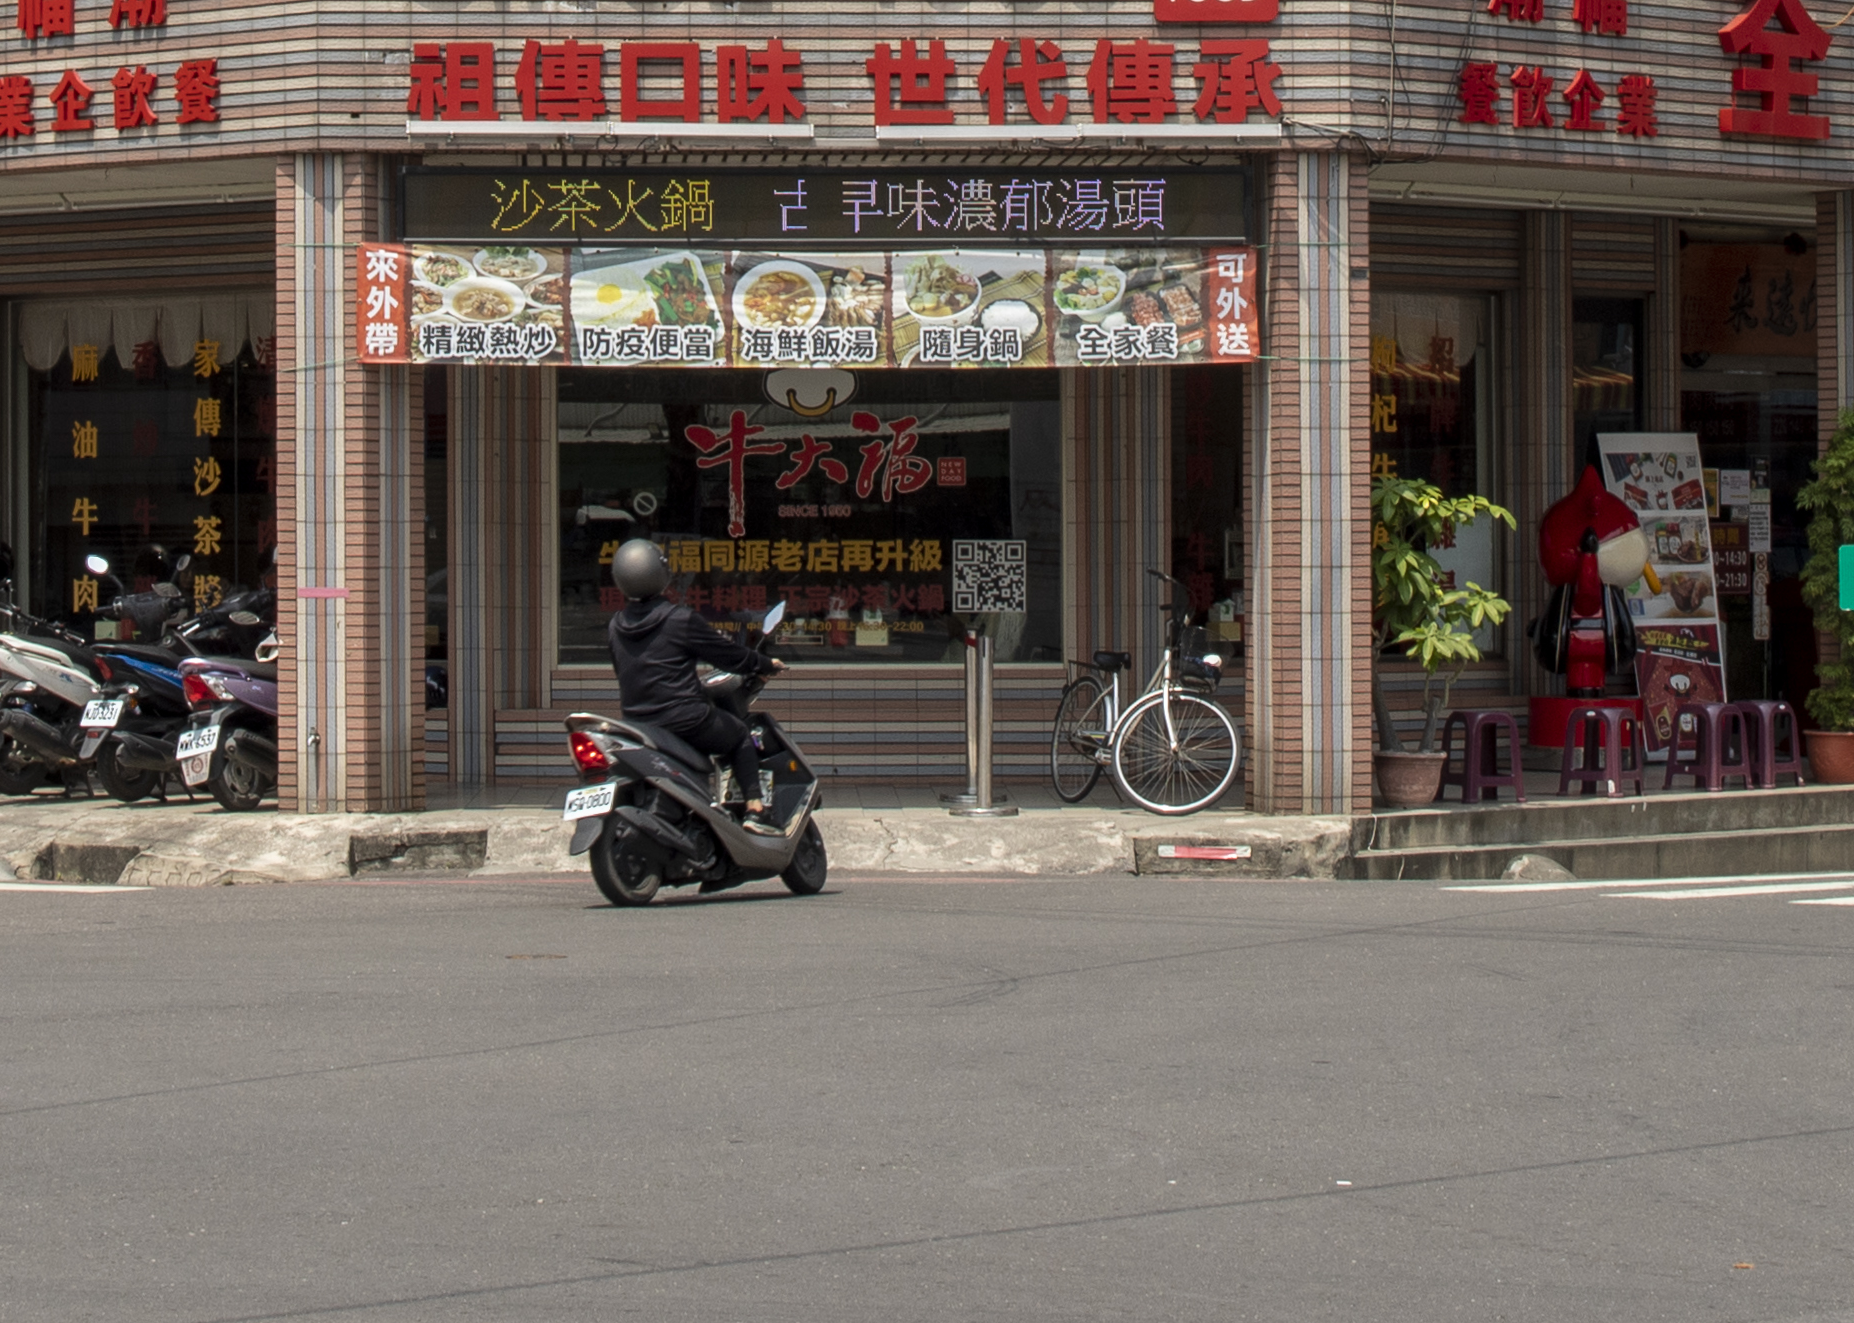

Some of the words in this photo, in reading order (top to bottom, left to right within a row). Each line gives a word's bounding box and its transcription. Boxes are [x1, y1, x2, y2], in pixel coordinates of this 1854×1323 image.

[407, 38, 807, 124] 祖傳口味
[866, 37, 1283, 126] 世代傳承
[1459, 61, 1660, 138] 餐飲企業
[489, 177, 716, 234] 沙茶火鍋
[364, 247, 401, 357] 來外帶
[1215, 252, 1252, 358] 可外送
[419, 322, 559, 359] 精緻熱炒
[579, 325, 716, 361] 防疫便當
[741, 325, 876, 361] 海鮮飯湯
[921, 325, 1023, 361] 隨身鍋
[1077, 323, 1180, 360] 全家餐
[71, 343, 99, 614] 麻油牛肉
[684, 409, 933, 538] 牛大福
[598, 539, 944, 573] 牛福同源老店再升級
